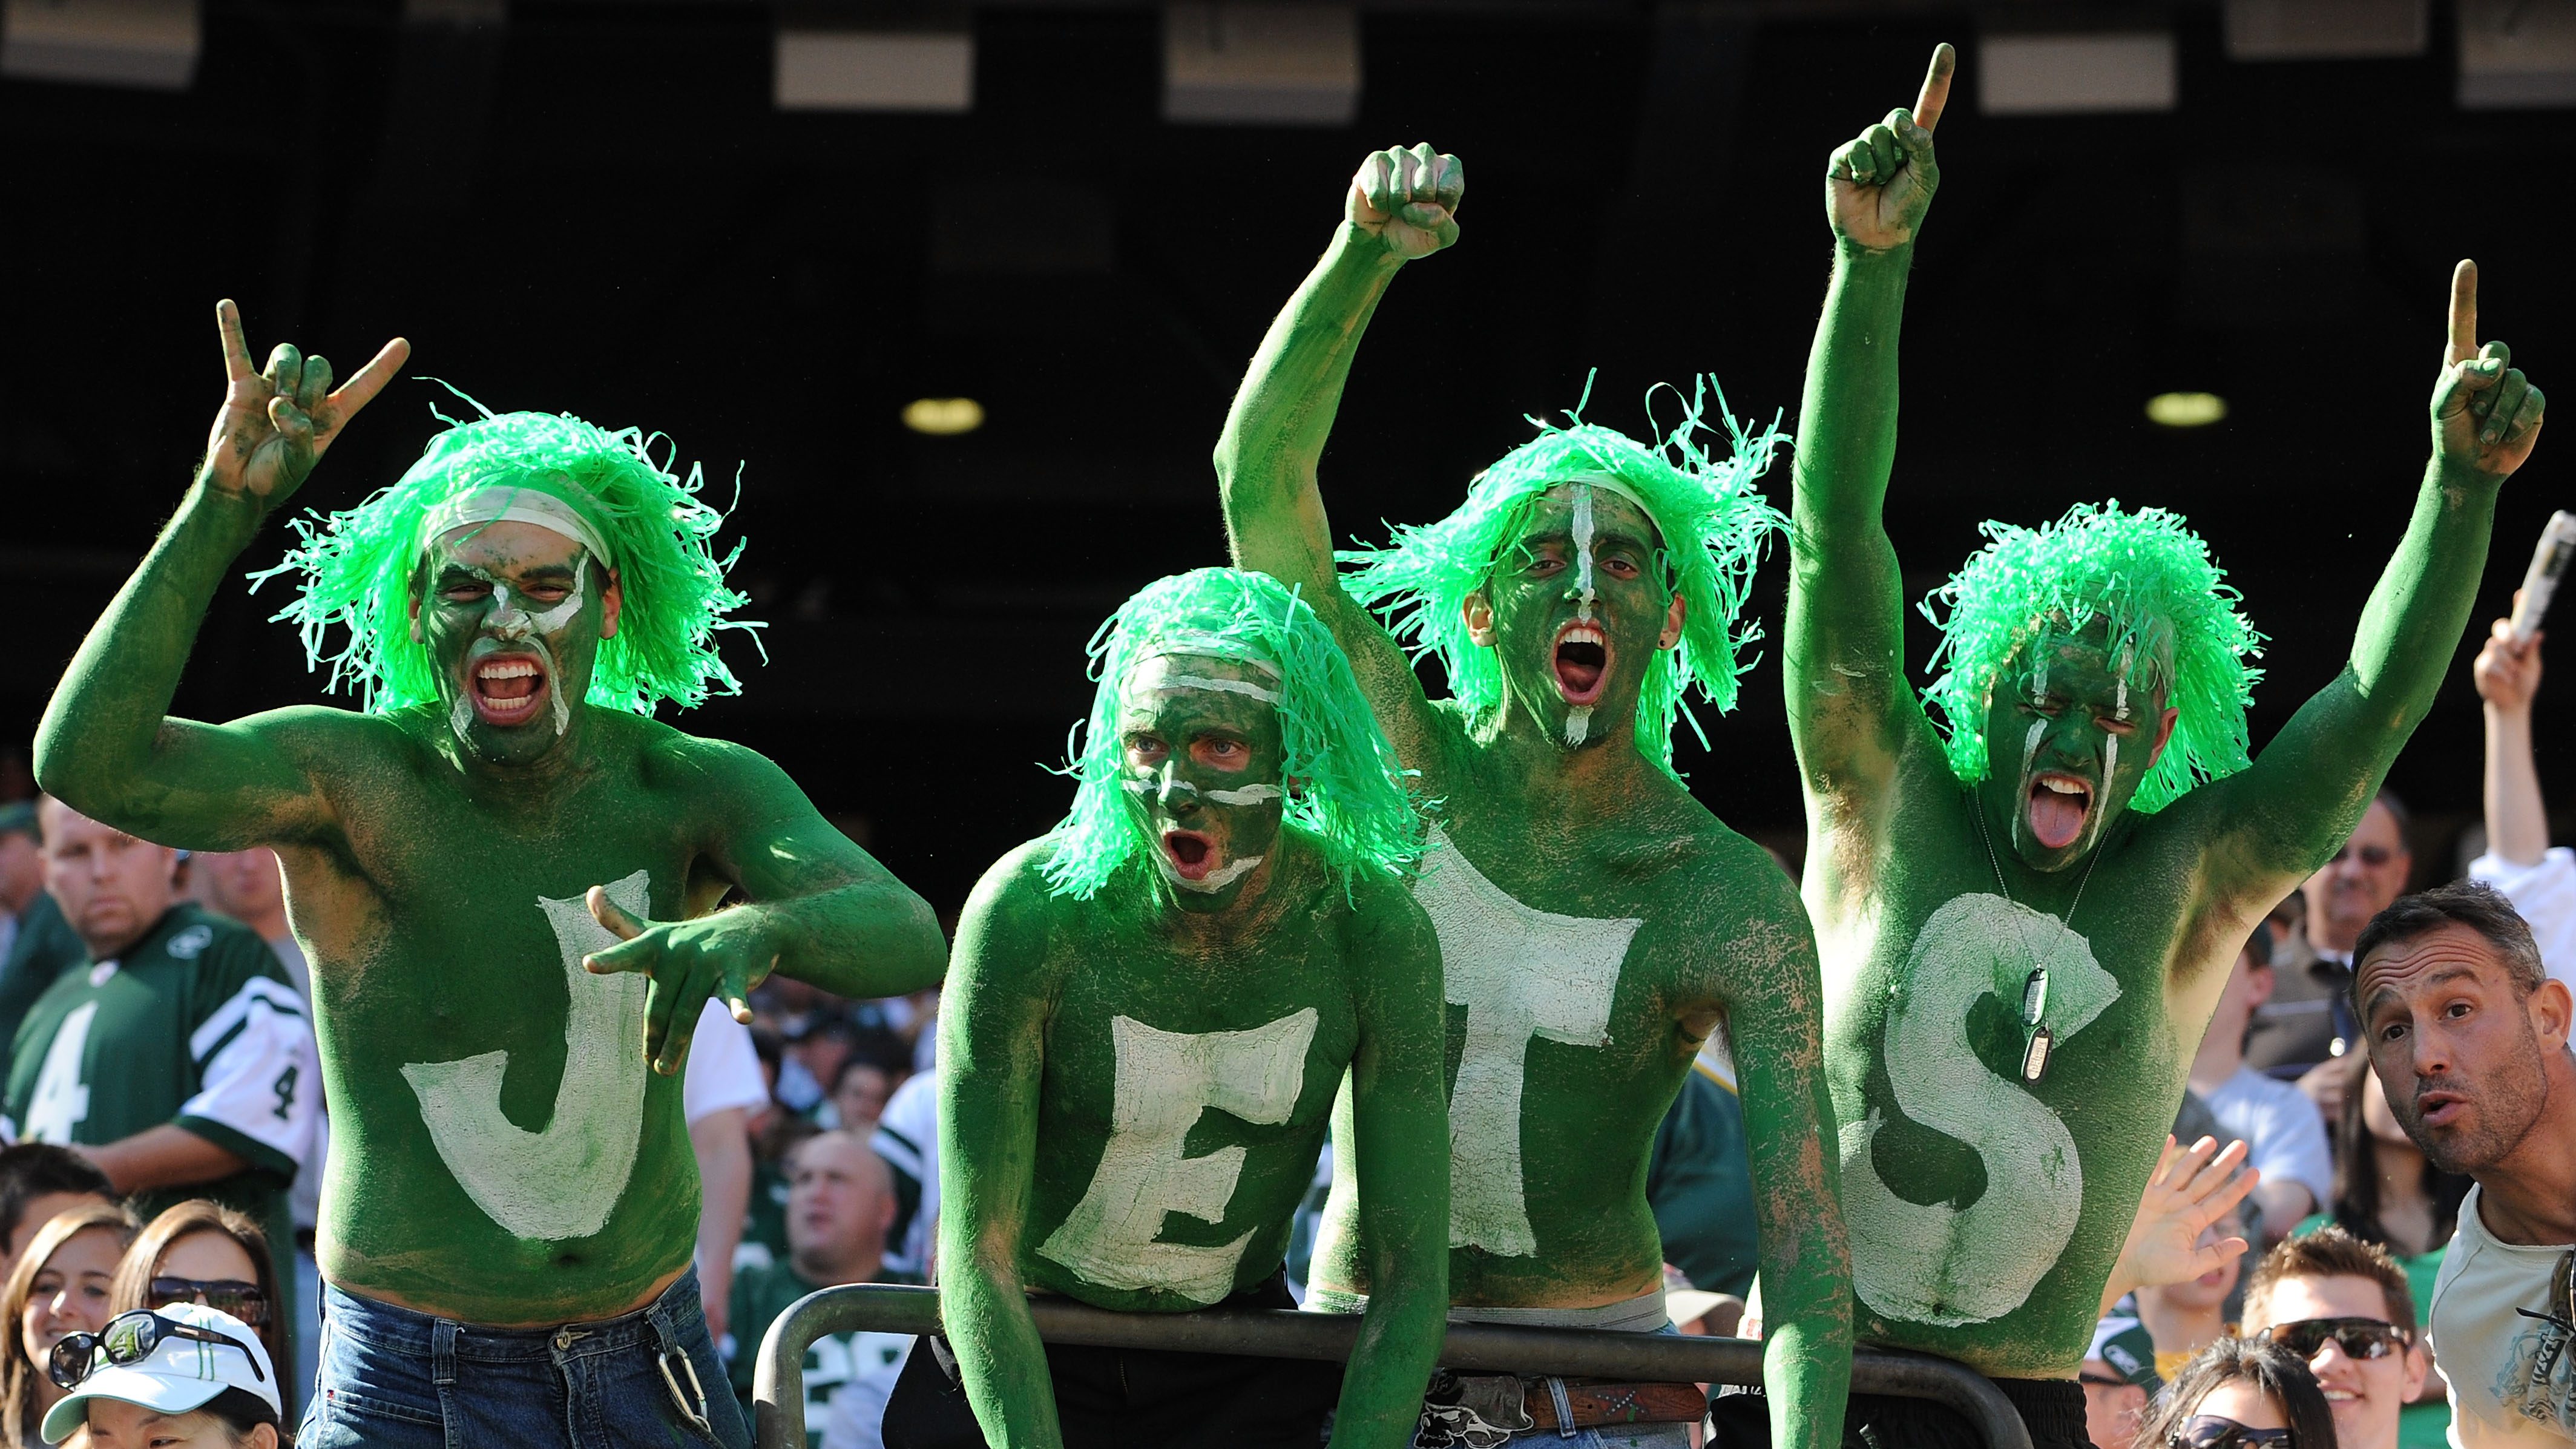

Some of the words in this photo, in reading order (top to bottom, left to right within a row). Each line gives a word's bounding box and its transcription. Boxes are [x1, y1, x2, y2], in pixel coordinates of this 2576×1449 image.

[25, 999, 91, 1146] 4
[273, 1065, 298, 1120] 4
[399, 869, 652, 1241] J
[1036, 1007, 1319, 1305] E
[1414, 824, 1643, 1258] T
[1839, 892, 2123, 1327] S
